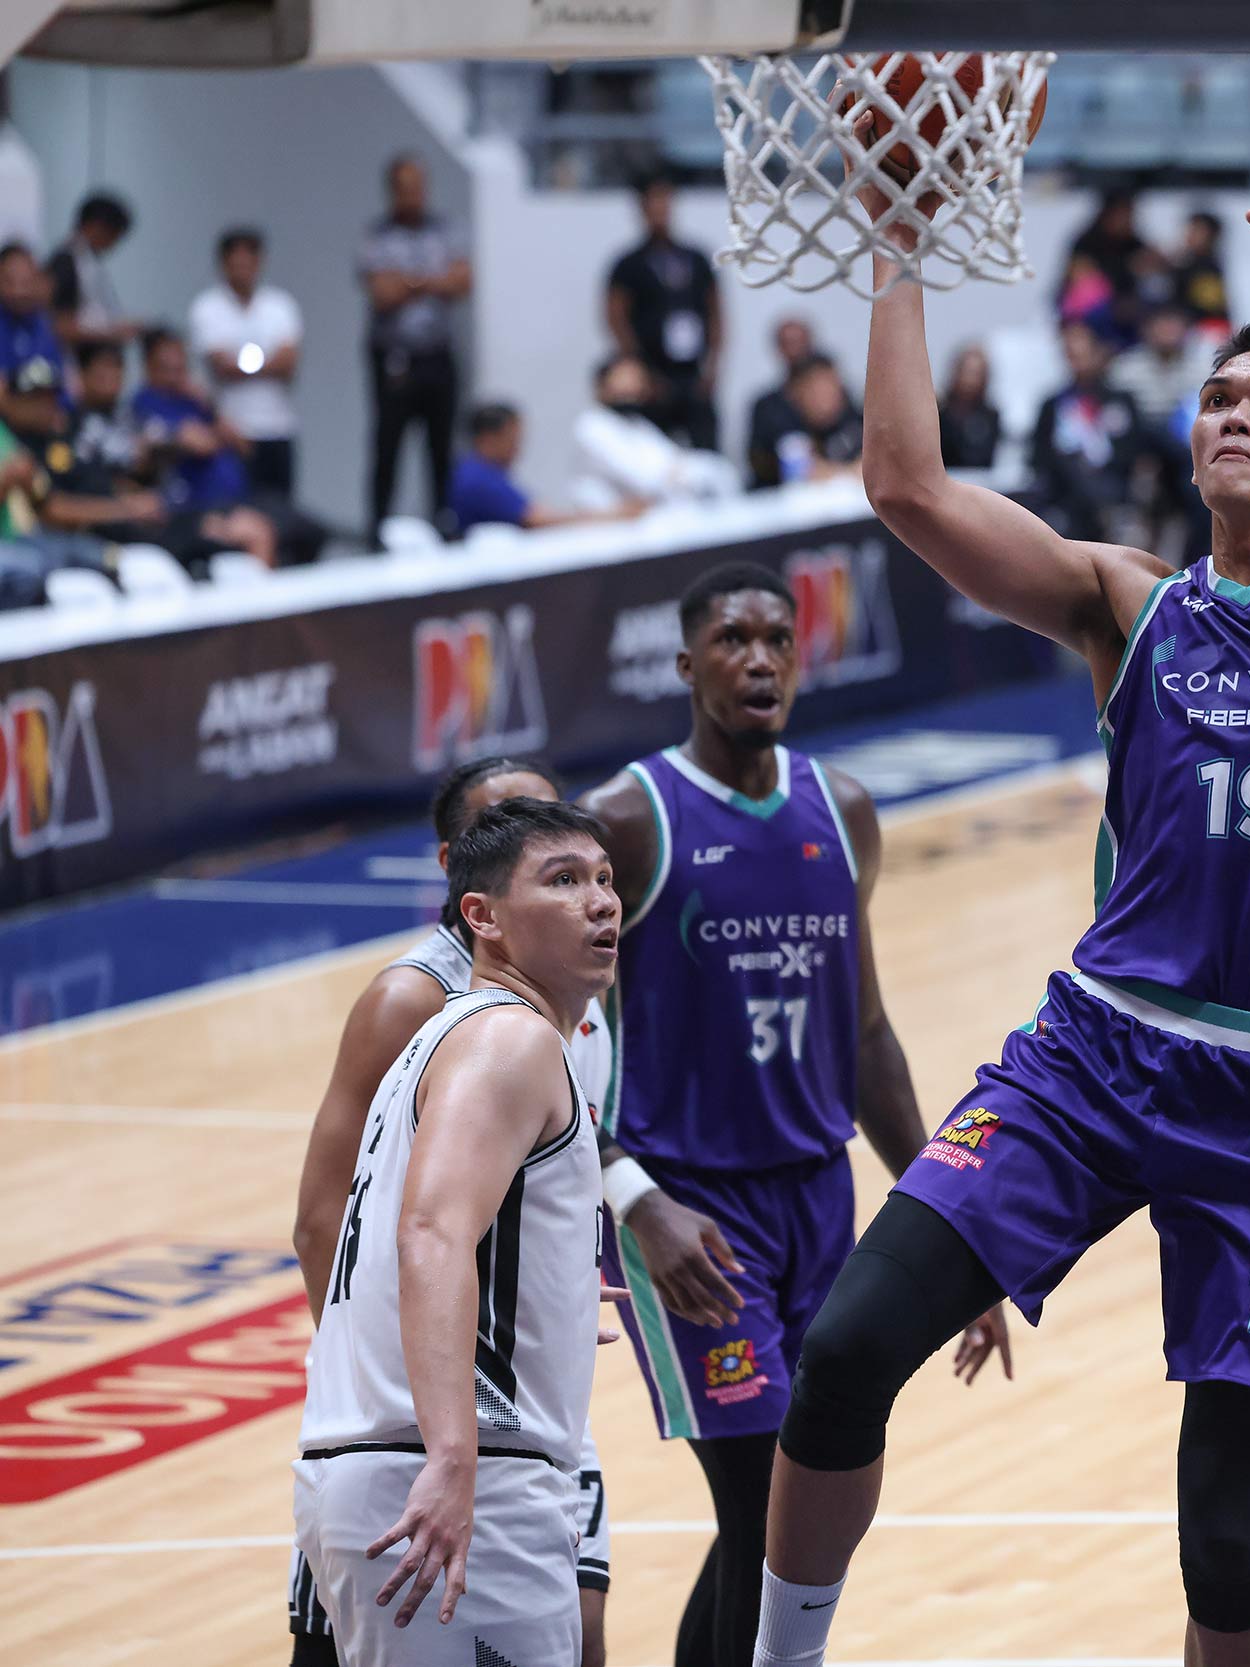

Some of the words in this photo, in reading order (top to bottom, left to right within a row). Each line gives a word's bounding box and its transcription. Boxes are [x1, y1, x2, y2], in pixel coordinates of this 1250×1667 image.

[0, 680, 112, 860] BA
[699, 914, 849, 942] CONVERGE
[746, 998, 809, 1065] 31
[938, 1127, 984, 1150] AWA
[953, 1149, 982, 1168] FIBER
